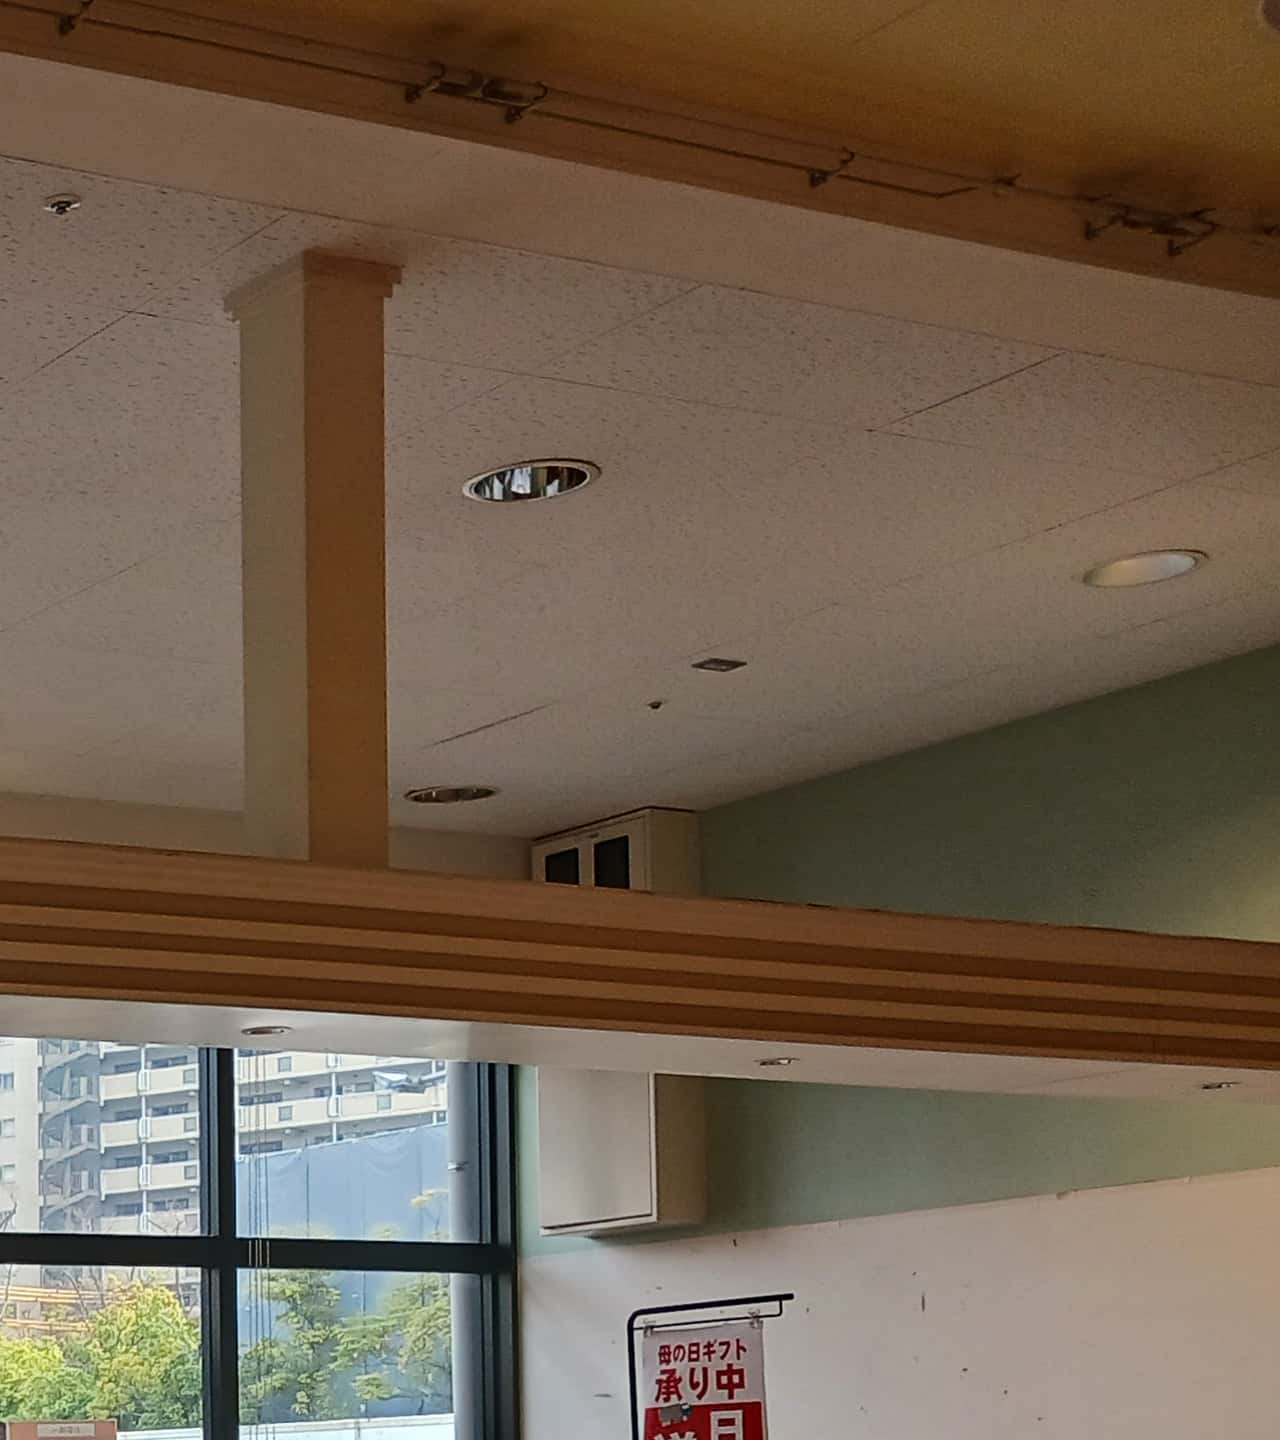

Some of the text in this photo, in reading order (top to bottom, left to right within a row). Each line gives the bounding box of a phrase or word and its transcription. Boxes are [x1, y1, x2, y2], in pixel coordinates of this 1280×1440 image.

[658, 1338, 748, 1367] 母の日ギフト
[655, 1367, 747, 1403] 承り中
